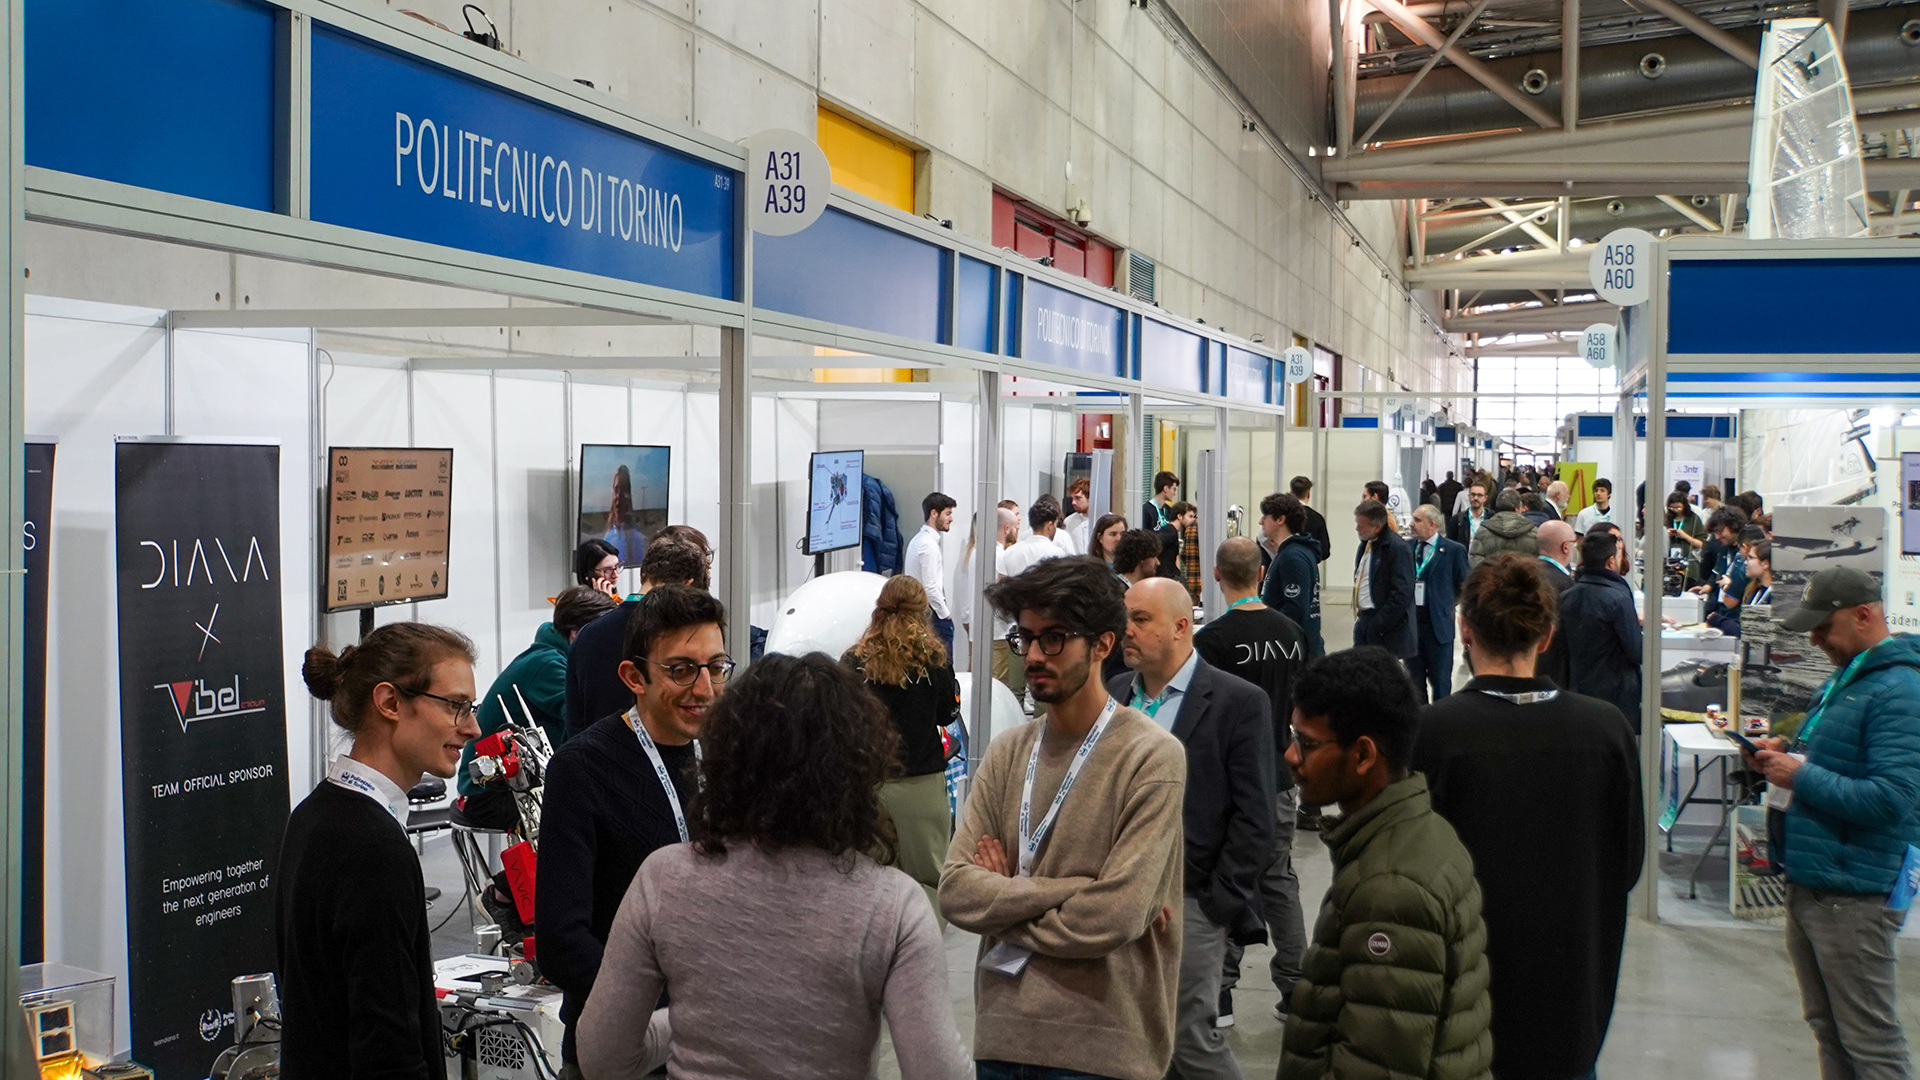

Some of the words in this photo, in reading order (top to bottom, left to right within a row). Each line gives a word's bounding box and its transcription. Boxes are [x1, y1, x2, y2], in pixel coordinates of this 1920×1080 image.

[765, 151, 800, 180] A31
[395, 111, 573, 227] POLITECNICO
[581, 167, 601, 234] DI
[607, 174, 683, 253] TORINO
[714, 174, 730, 191] A31-39
[765, 184, 806, 213] A39
[1603, 244, 1634, 266] A58
[1603, 268, 1634, 289] A60
[1037, 307, 1080, 349] POLITECNICO
[1086, 321, 1109, 355] TORINO
[1587, 333, 1605, 346] A58
[1290, 354, 1303, 365] A31
[1587, 347, 1605, 360] A60
[1289, 365, 1303, 376] A39
[1386, 398, 1397, 406] A27
[152, 781, 180, 799] TEAM
[183, 774, 226, 793] OFFICIAL
[228, 764, 274, 784] SPONSOR
[162, 869, 223, 893] Empowering
[226, 859, 264, 879] together
[162, 900, 179, 914] the
[183, 893, 204, 909] next
[207, 880, 257, 905] generation
[259, 874, 269, 889] of
[195, 904, 242, 926] engineers
